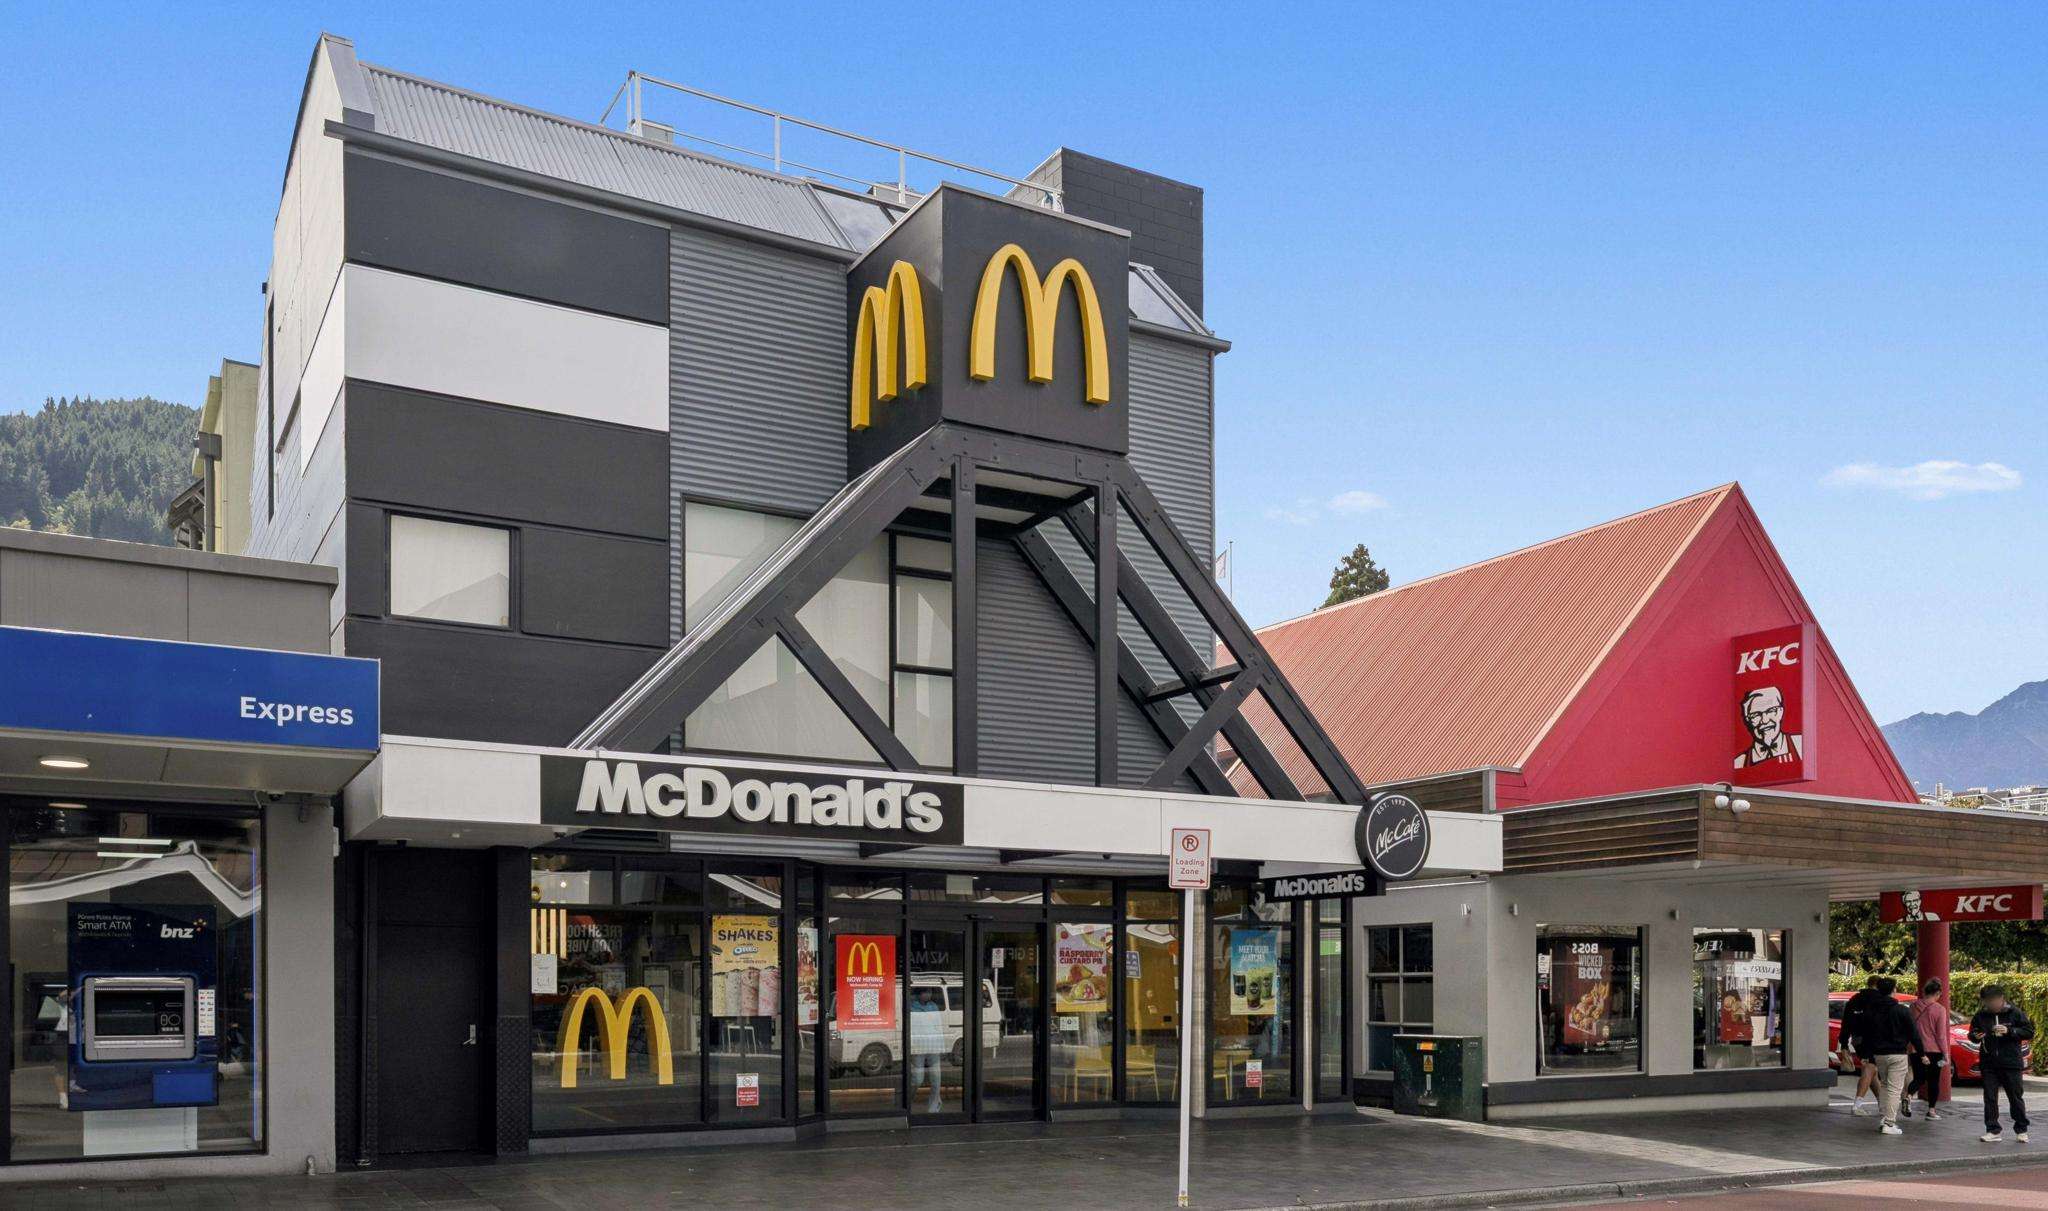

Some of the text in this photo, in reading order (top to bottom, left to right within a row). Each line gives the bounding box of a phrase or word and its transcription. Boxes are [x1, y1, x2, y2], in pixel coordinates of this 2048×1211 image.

[1736, 642, 1800, 675] KFC
[240, 696, 354, 726] Express
[576, 760, 943, 833] McDonald's
[1375, 813, 1421, 855] McCafé
[1175, 858, 1205, 867] Loading
[1180, 867, 1199, 875] Zone
[1273, 873, 1366, 898] McDonald's
[1953, 893, 2014, 914] KFC
[78, 920, 132, 930] Smart ATM
[160, 924, 194, 938] bnz
[717, 927, 773, 942] SHAKES
[1059, 950, 1104, 958] RASPBERRY
[1578, 967, 1602, 979] BOX
